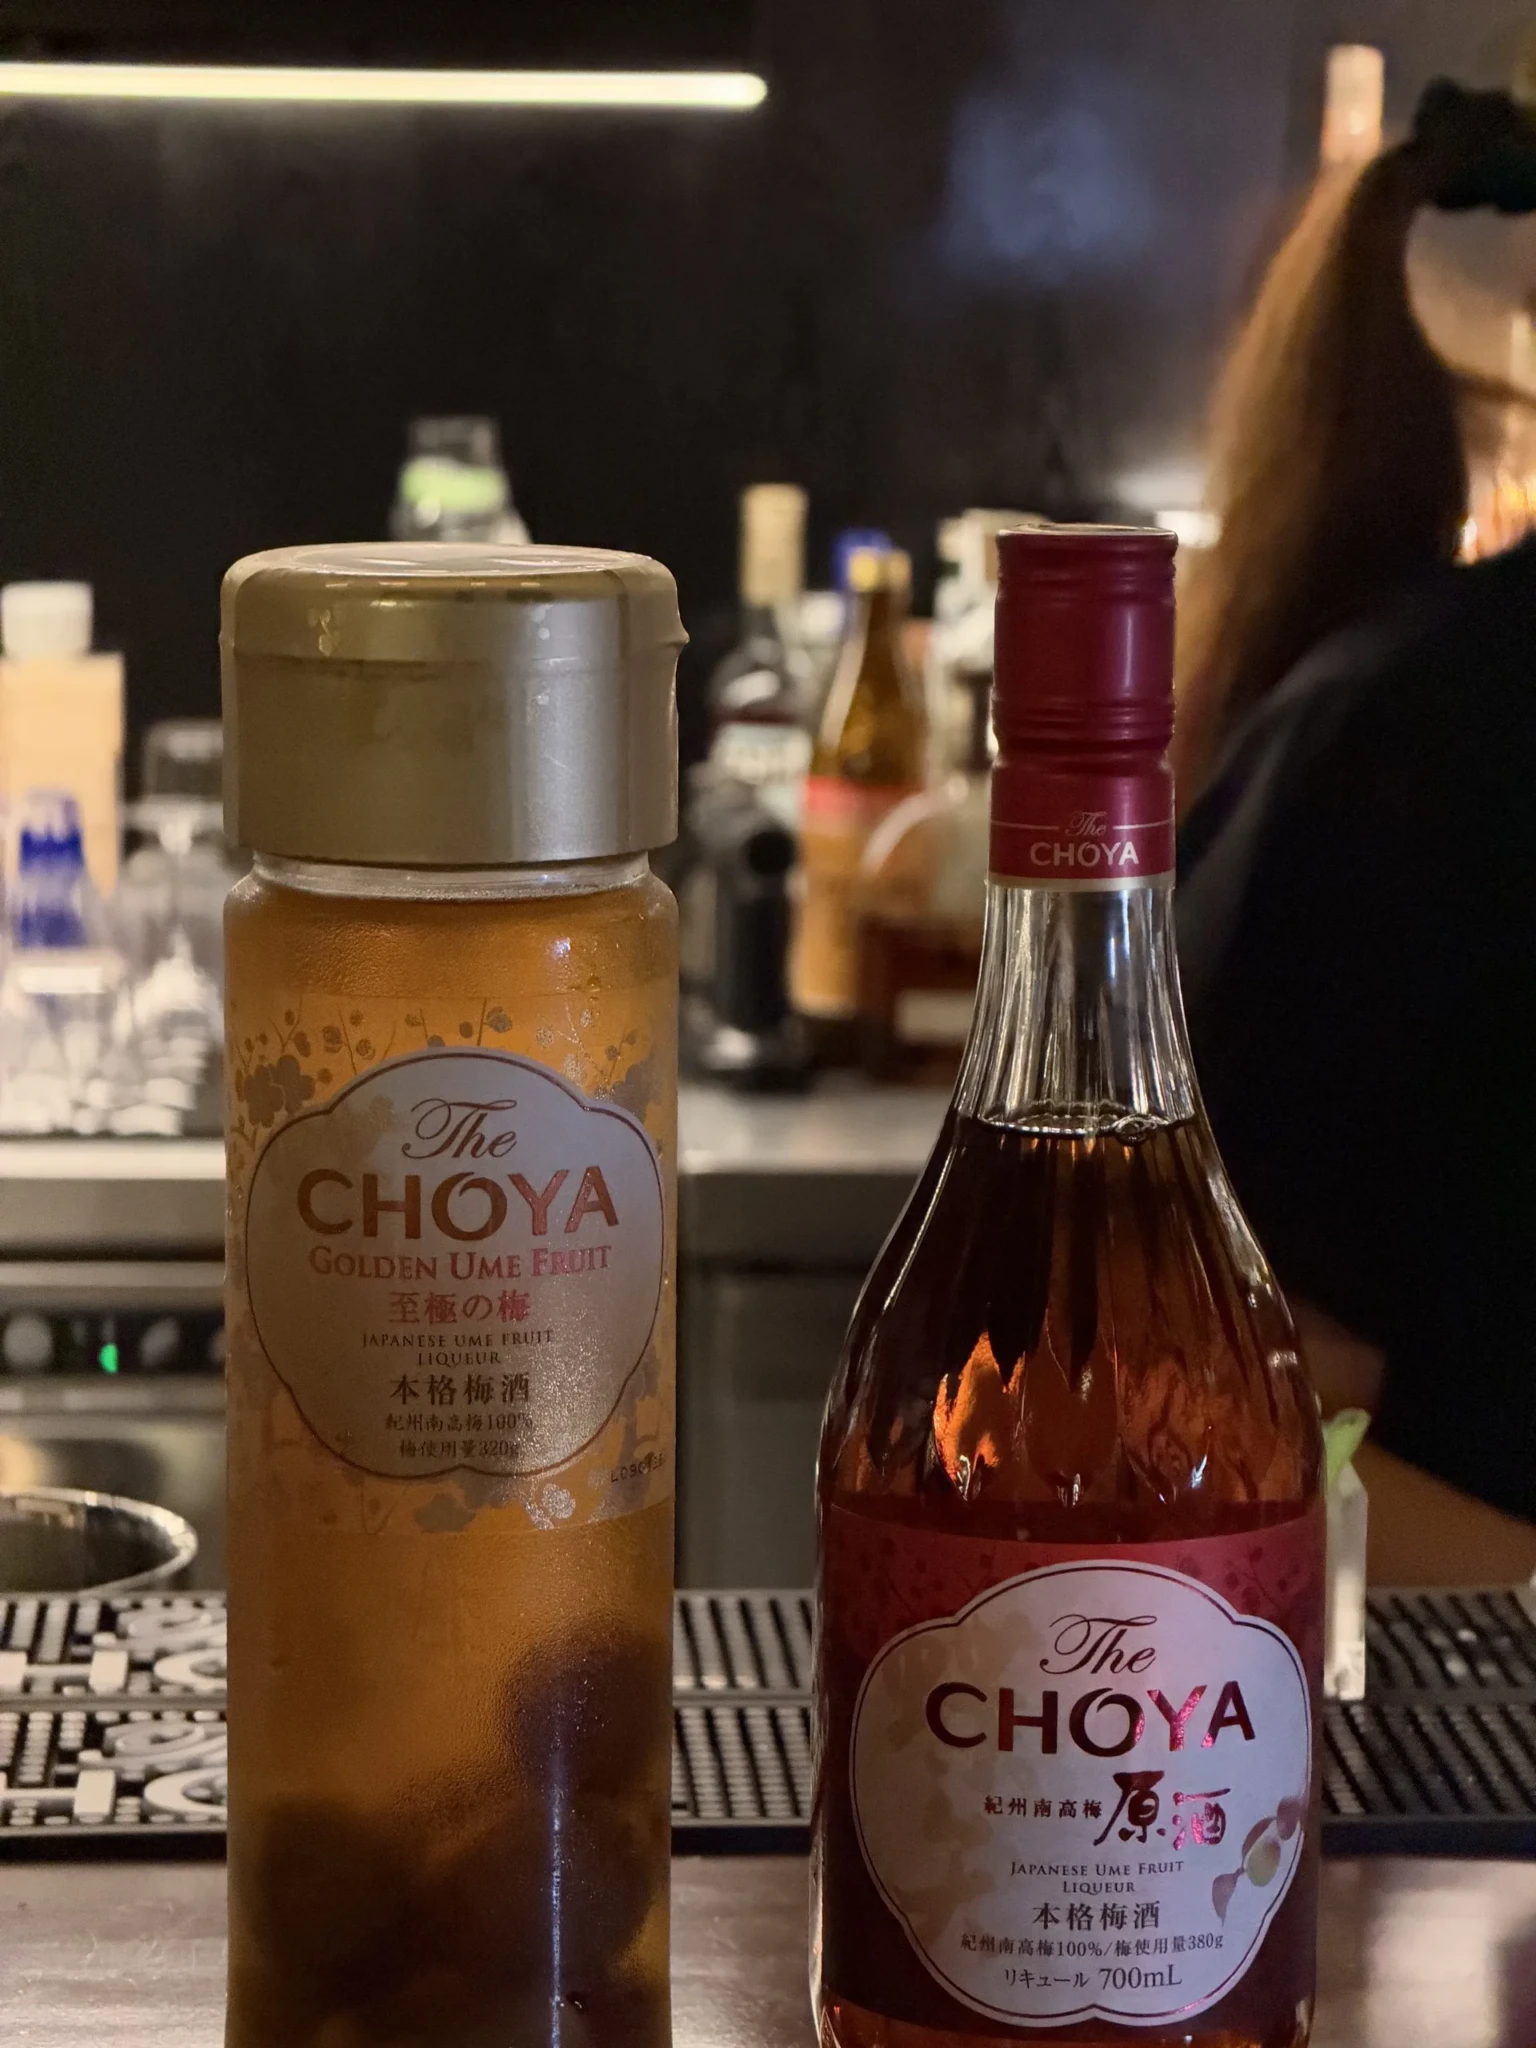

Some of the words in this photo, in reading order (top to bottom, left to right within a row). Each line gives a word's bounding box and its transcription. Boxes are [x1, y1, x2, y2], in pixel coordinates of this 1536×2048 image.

[1065, 811, 1107, 837] The
[1030, 841, 1139, 867] CHOYA
[401, 1099, 518, 1160] The
[297, 1165, 620, 1241] CHOYA
[308, 1245, 438, 1280] GOLDEN
[448, 1251, 521, 1280] UME
[530, 1245, 612, 1277] FRUIT
[388, 1289, 531, 1325] 至極の梅
[361, 1332, 447, 1348] JAPANESE
[454, 1333, 494, 1347] UME
[502, 1329, 554, 1346] FRUIT
[417, 1351, 502, 1368] LIQUEUR
[388, 1371, 530, 1406] 本格梅酒
[1039, 1614, 1157, 1674] The
[925, 1681, 1255, 1757] CHOYA
[1010, 1861, 1088, 1877] JAPANESE
[1096, 1863, 1131, 1876] UME
[1138, 1860, 1184, 1875] FRUIT
[1063, 1881, 1136, 1895] LIQUEUR
[1032, 1900, 1160, 1931] 本格梅酒
[1004, 1968, 1090, 1989] リキュール
[1099, 1963, 1183, 1990] 700mL
